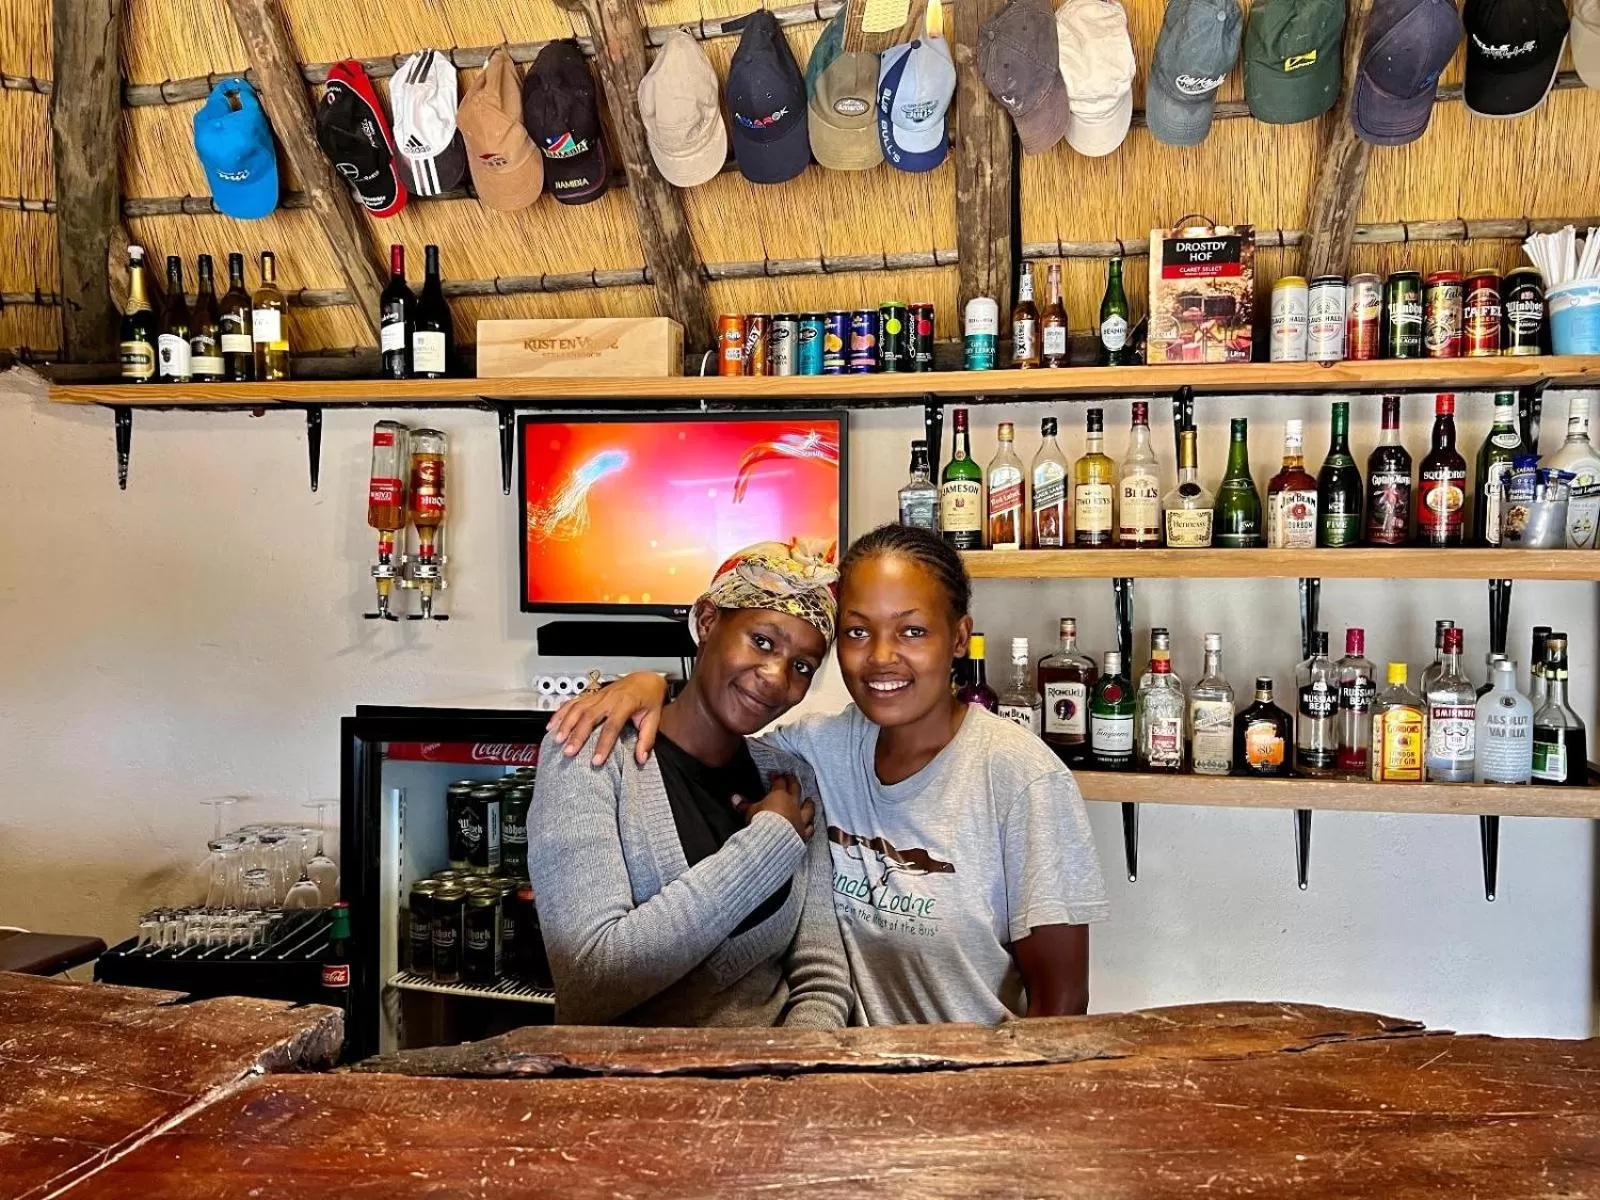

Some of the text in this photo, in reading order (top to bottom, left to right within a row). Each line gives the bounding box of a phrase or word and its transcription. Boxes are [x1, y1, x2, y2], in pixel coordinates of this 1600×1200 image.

[1175, 241, 1227, 252] DROSTDY
[1189, 252, 1213, 262] HOF
[1464, 306, 1502, 318] TAFEL
[560, 339, 575, 349] EN
[1393, 475, 1411, 485] Morga
[942, 485, 979, 497] JAMESON
[1295, 491, 1316, 508] BEAM
[1343, 688, 1375, 697] RUSSIAN
[1303, 694, 1336, 703] RUSSIAN
[1308, 702, 1331, 711] BEAR
[1011, 708, 1031, 723] BEAM
[1487, 715, 1528, 724] ABSOLUT
[878, 884, 936, 915] Lodge
[858, 907, 870, 922] the
[901, 921, 916, 935] the
